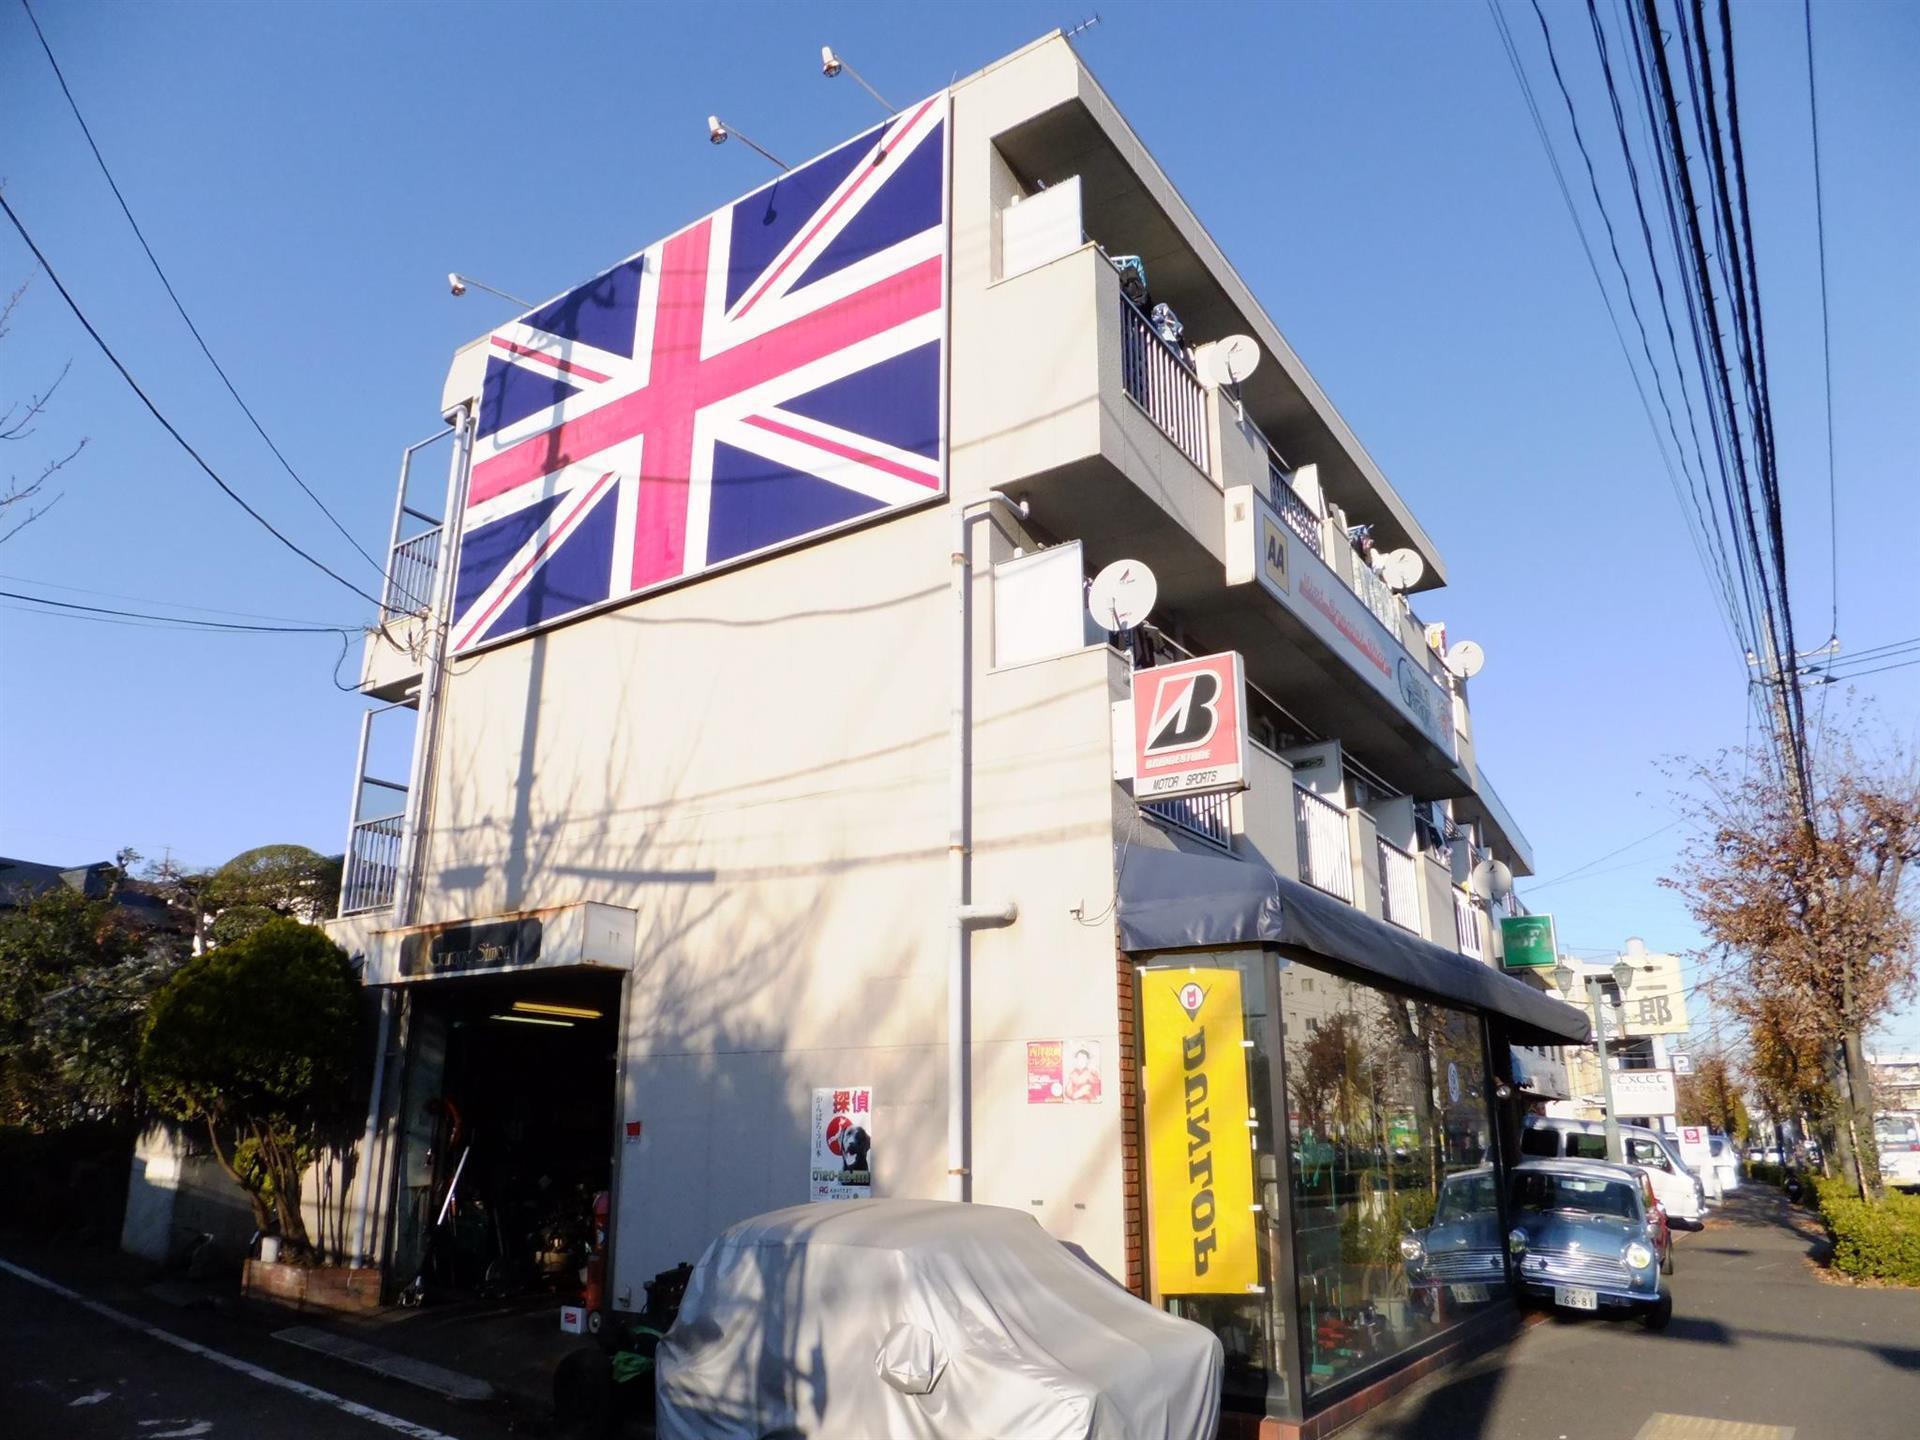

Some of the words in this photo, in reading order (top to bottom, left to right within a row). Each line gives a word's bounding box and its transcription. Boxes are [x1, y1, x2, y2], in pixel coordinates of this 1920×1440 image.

[1267, 535, 1285, 574] AA
[1153, 776, 1179, 790] MOTOR
[1185, 770, 1218, 786] SPORTS
[833, 1090, 869, 1113] 探偵
[1564, 1295, 1593, 1307] 66-81
